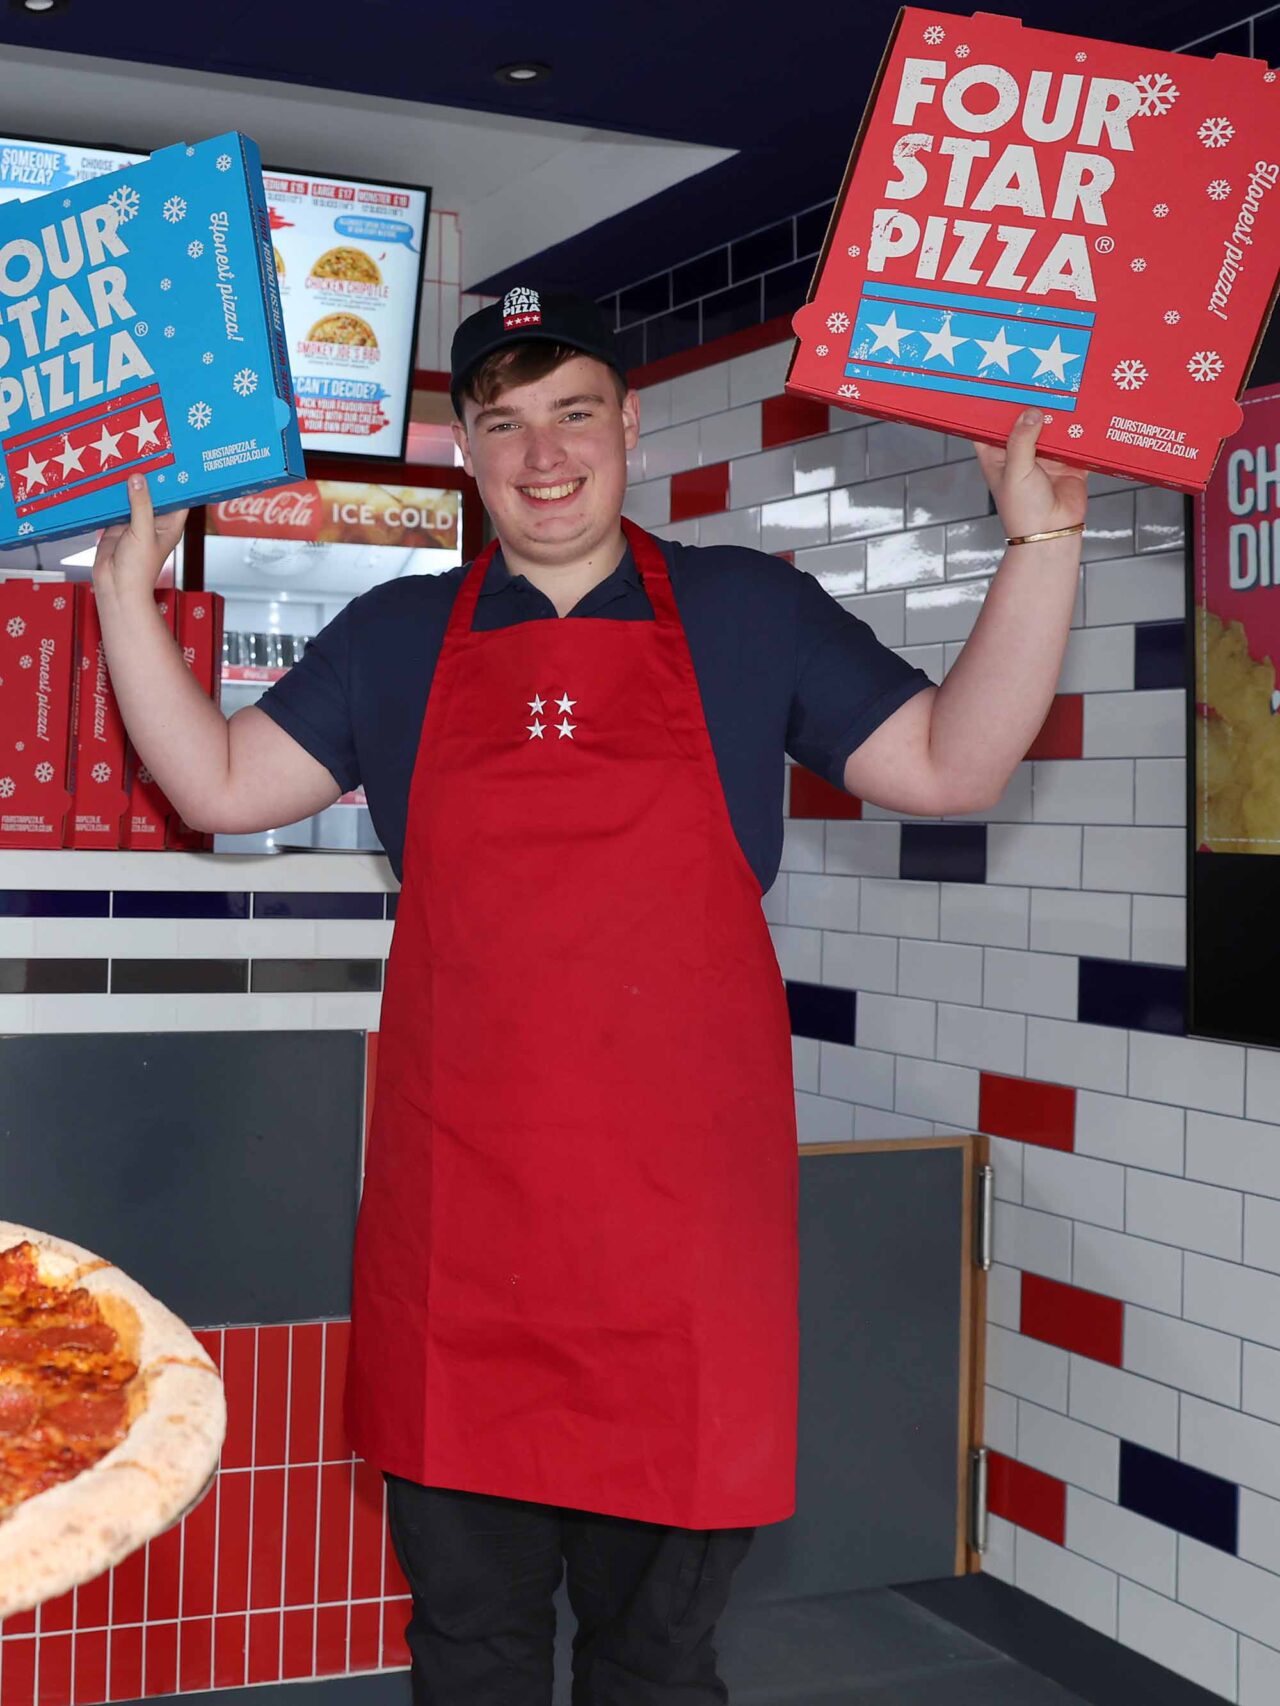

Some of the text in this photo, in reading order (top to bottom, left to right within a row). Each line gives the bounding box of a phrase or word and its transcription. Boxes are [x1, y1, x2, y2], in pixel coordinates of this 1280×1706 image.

[891, 57, 1143, 152] FOUR
[2, 147, 61, 171] SOMEONE
[81, 157, 113, 170] CHOOSE
[10, 166, 54, 186] PIZZA?
[883, 133, 1116, 226] STAR
[1207, 160, 1279, 321] Honest pizza!
[210, 211, 244, 342] Honest pizza!
[262, 242, 276, 287] DOUGH
[305, 277, 389, 299] CHICKEN CHIPOTLE
[504, 287, 539, 302] FOUR
[270, 288, 283, 332] FRESH
[502, 303, 541, 318] PIZZA
[504, 295, 539, 309] STAR
[298, 341, 333, 357] SMOKEY
[296, 377, 378, 399] CAN'T DECIDE?
[1105, 428, 1200, 460] FOURSTARPIZZA.CO.UK
[1110, 416, 1187, 445] FOURSTARPIZZA.IE
[202, 438, 257, 462] FOURSTARPIZZA.IE
[203, 446, 271, 472] FOURSTARPIZZA.CO.UK
[332, 503, 454, 531] ICE COLD
[36, 638, 55, 742] Honest pizza!
[93, 692, 109, 743] pizza!
